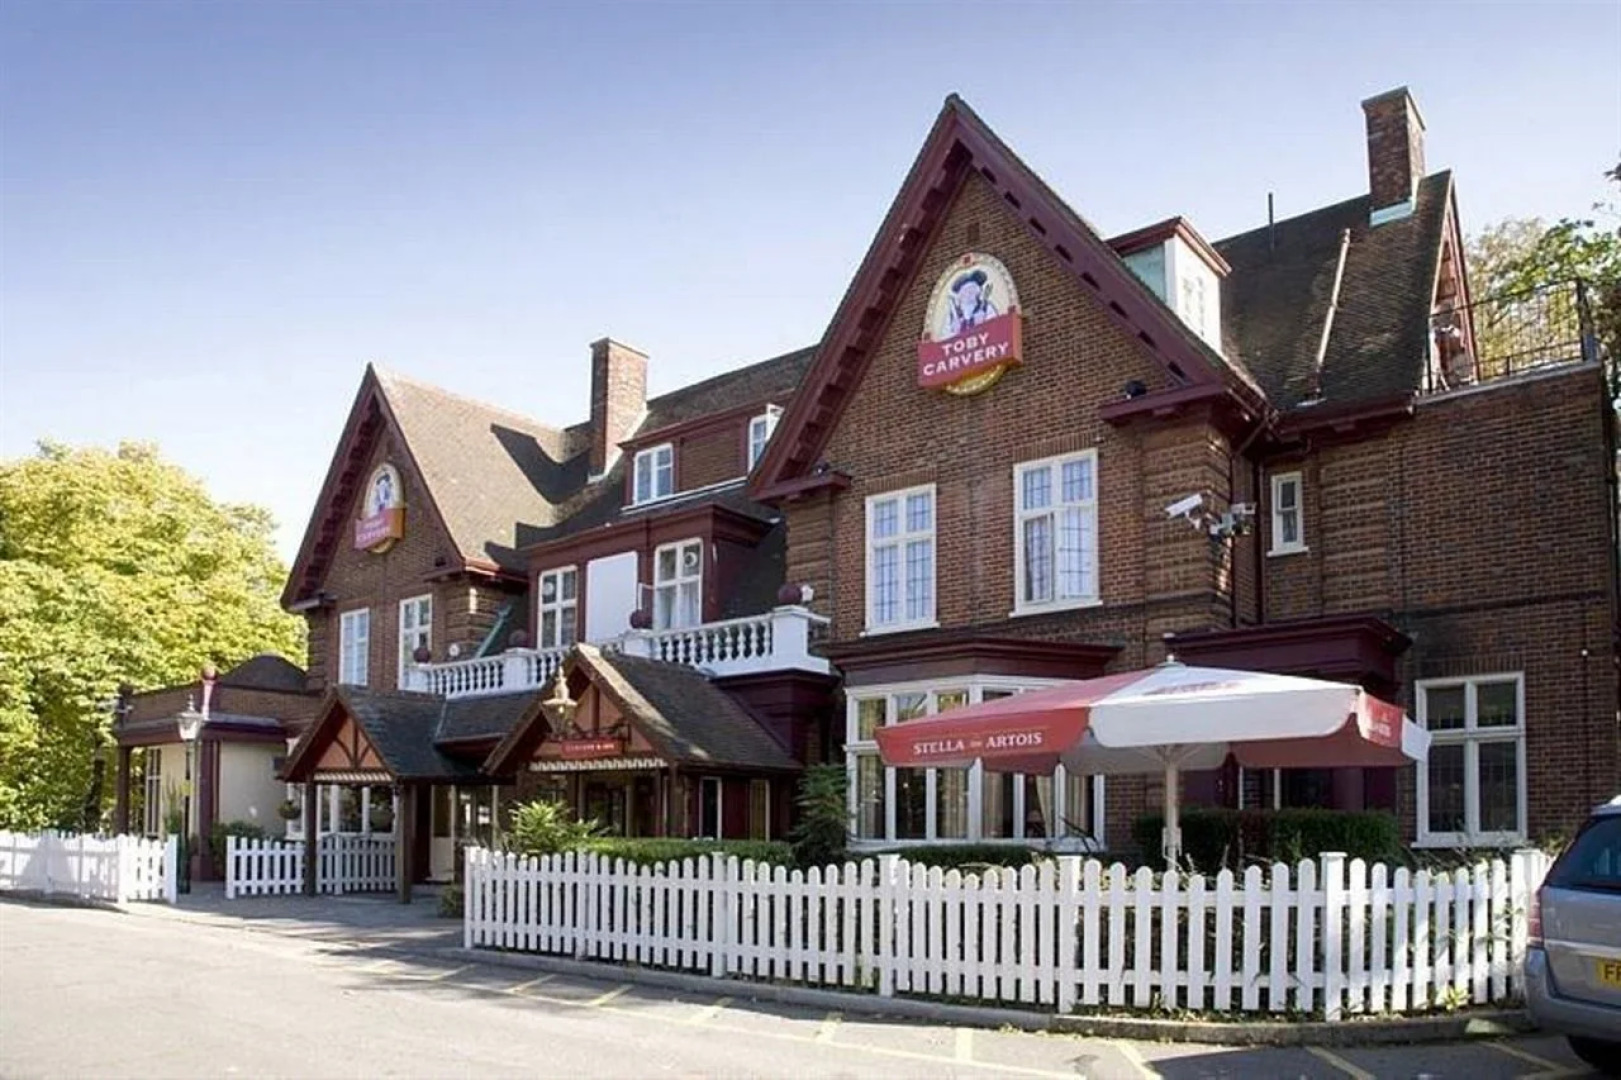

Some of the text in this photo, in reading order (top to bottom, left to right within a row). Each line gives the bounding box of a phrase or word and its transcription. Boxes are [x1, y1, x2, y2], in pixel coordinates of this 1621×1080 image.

[941, 332, 989, 356] TOBY
[923, 342, 1009, 376] CARVERY
[913, 739, 965, 755] STELLA
[985, 732, 1043, 749] ARTOIS
